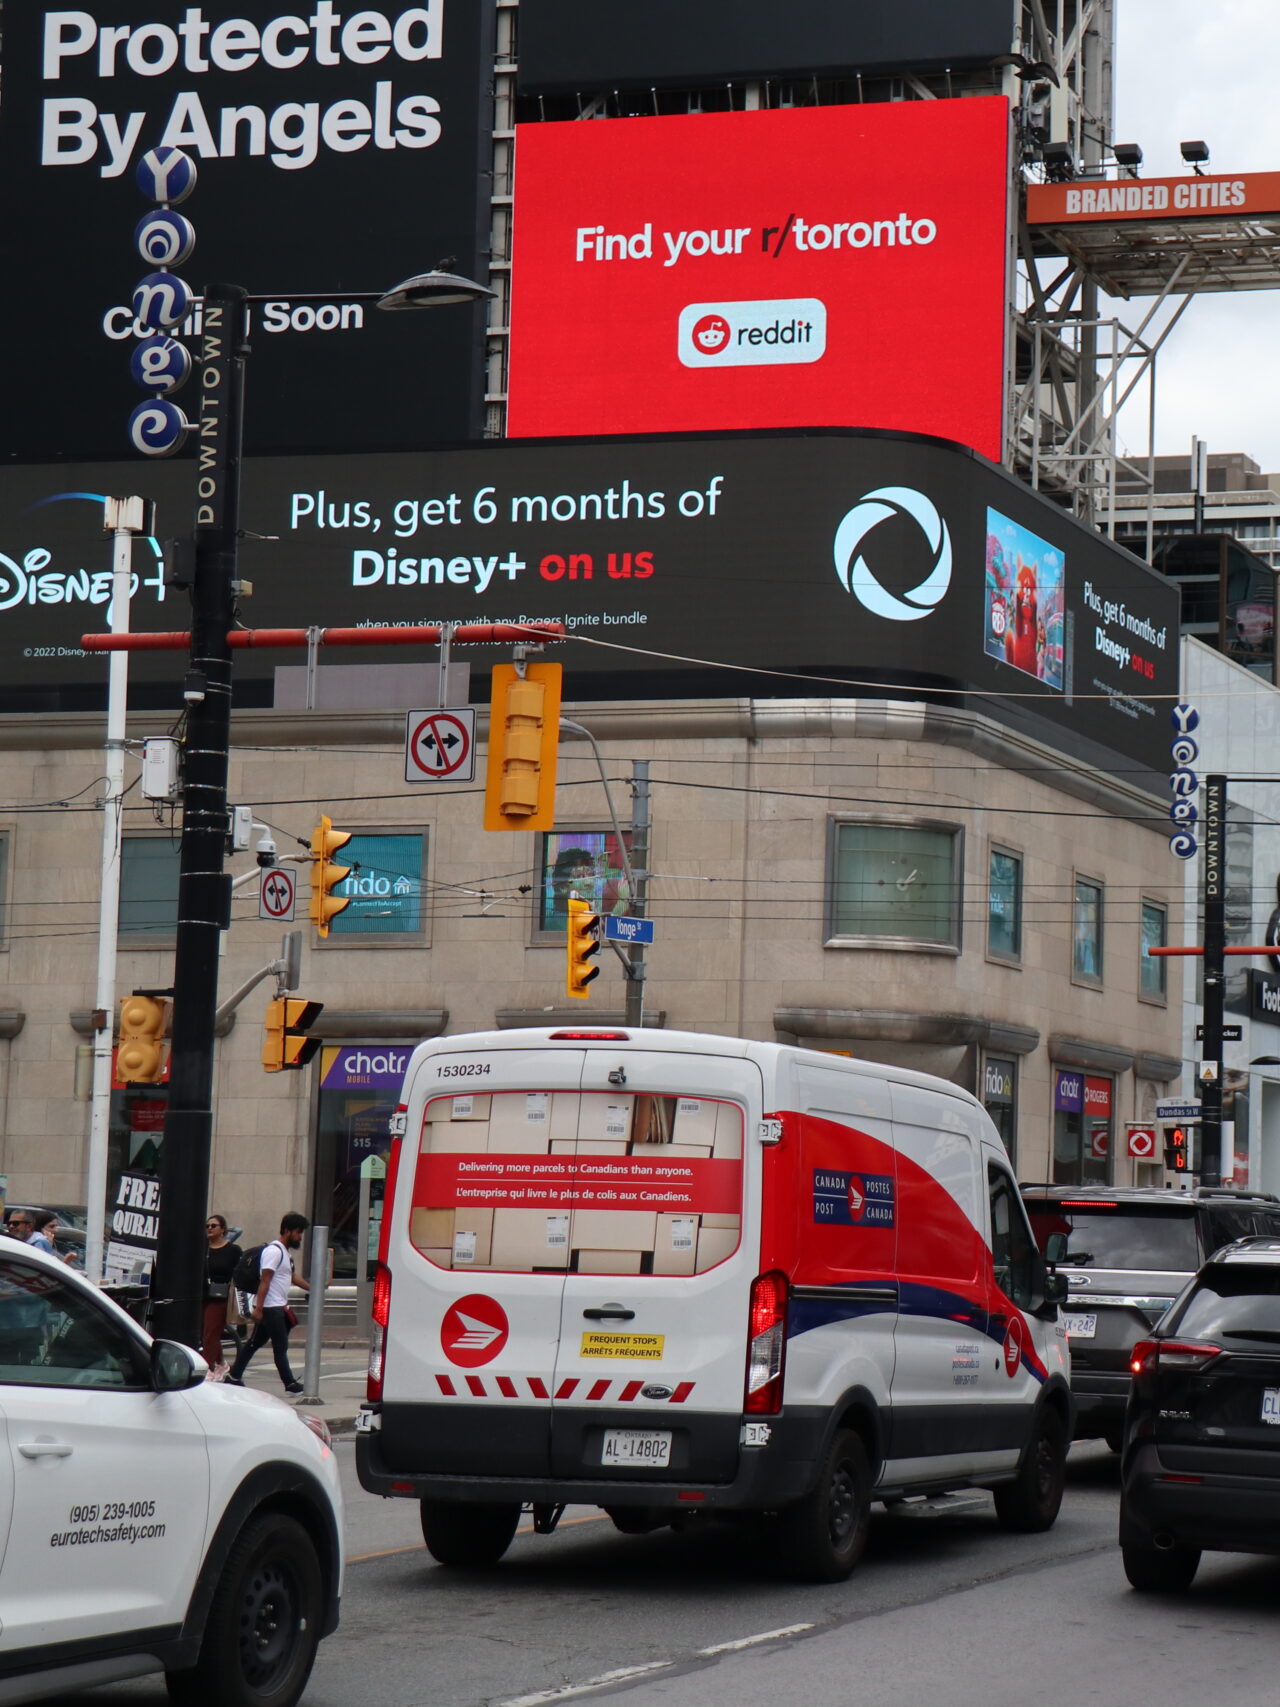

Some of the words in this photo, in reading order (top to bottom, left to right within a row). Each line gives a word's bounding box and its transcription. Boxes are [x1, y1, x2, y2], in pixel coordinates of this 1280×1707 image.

[42, 0, 444, 79] Protected
[41, 97, 146, 177] By
[157, 81, 441, 170] Angels
[1066, 184, 1168, 215] BRANDED
[1174, 181, 1245, 210] CITIES
[576, 224, 652, 262] Find
[664, 224, 750, 265] your
[761, 213, 936, 258] r/toronto
[131, 152, 193, 456] Yonge
[263, 302, 363, 333] Soon
[737, 319, 812, 347] reddit
[197, 306, 223, 524] DOWNTOWN
[291, 493, 380, 532] Plus,
[395, 492, 461, 537] get
[474, 487, 497, 523] 6
[512, 480, 665, 523] months
[678, 476, 724, 516] of
[353, 547, 526, 594] Disney+
[540, 552, 593, 581] on
[608, 549, 654, 579] us
[356, 619, 390, 629] when
[465, 616, 492, 626] with
[519, 614, 562, 626] Rogers
[565, 613, 600, 628] Ignite
[603, 611, 648, 626] bundle
[1084, 581, 1103, 617] Plus,
[1104, 600, 1118, 624] get
[1119, 604, 1126, 627] 6
[1126, 614, 1157, 645] months
[1157, 627, 1166, 650] of
[34, 647, 56, 657] 2022
[1095, 626, 1130, 669] Disney+
[1132, 654, 1143, 674] on
[1145, 659, 1154, 680] us
[1171, 705, 1198, 858] Yonge
[1208, 785, 1220, 895] DOWNTOWN
[616, 918, 636, 940] Yonge
[1262, 981, 1280, 1013] Foot
[344, 1052, 404, 1073] chatr
[436, 1064, 490, 1078] 1530234
[346, 1075, 371, 1084] MOBILE
[986, 1066, 1003, 1094] fido
[1060, 1077, 1079, 1098] chatr
[1088, 1090, 1108, 1104] ROGERS
[1160, 1108, 1185, 1116] Dundas
[353, 1138, 371, 1148] $15
[459, 1162, 504, 1173] Delivering
[507, 1165, 531, 1173] more
[533, 1163, 565, 1174] parcels
[567, 1164, 577, 1173] to
[580, 1163, 628, 1174] Canadians
[631, 1164, 653, 1174] than
[655, 1167, 693, 1177] anyone.
[815, 1175, 846, 1189] CANADA
[866, 1182, 890, 1194] POSTES
[116, 1175, 160, 1212] FRE
[456, 1187, 507, 1199] L'entreprise
[509, 1188, 524, 1199] qui
[526, 1187, 547, 1198] livre
[550, 1188, 558, 1198] le
[560, 1188, 580, 1200] plus
[582, 1188, 594, 1199] de
[597, 1189, 618, 1200] colis
[620, 1192, 637, 1200] aux
[639, 1190, 692, 1202] Canadiens.
[815, 1202, 834, 1215] POST
[866, 1206, 893, 1220] CANADA
[1078, 1320, 1094, 1331] 242
[589, 1335, 631, 1344] FREQUENT
[633, 1337, 657, 1345] STOPS
[583, 1346, 612, 1355] ARRÊTS
[615, 1347, 661, 1357] FRÉQUENTS
[646, 1386, 667, 1397] Ford
[605, 1439, 619, 1457] AL
[629, 1440, 668, 1458] 14802
[69, 1503, 100, 1524] (905)
[103, 1501, 155, 1520] 239-1005
[50, 1522, 165, 1547] eurotechsafety.com
